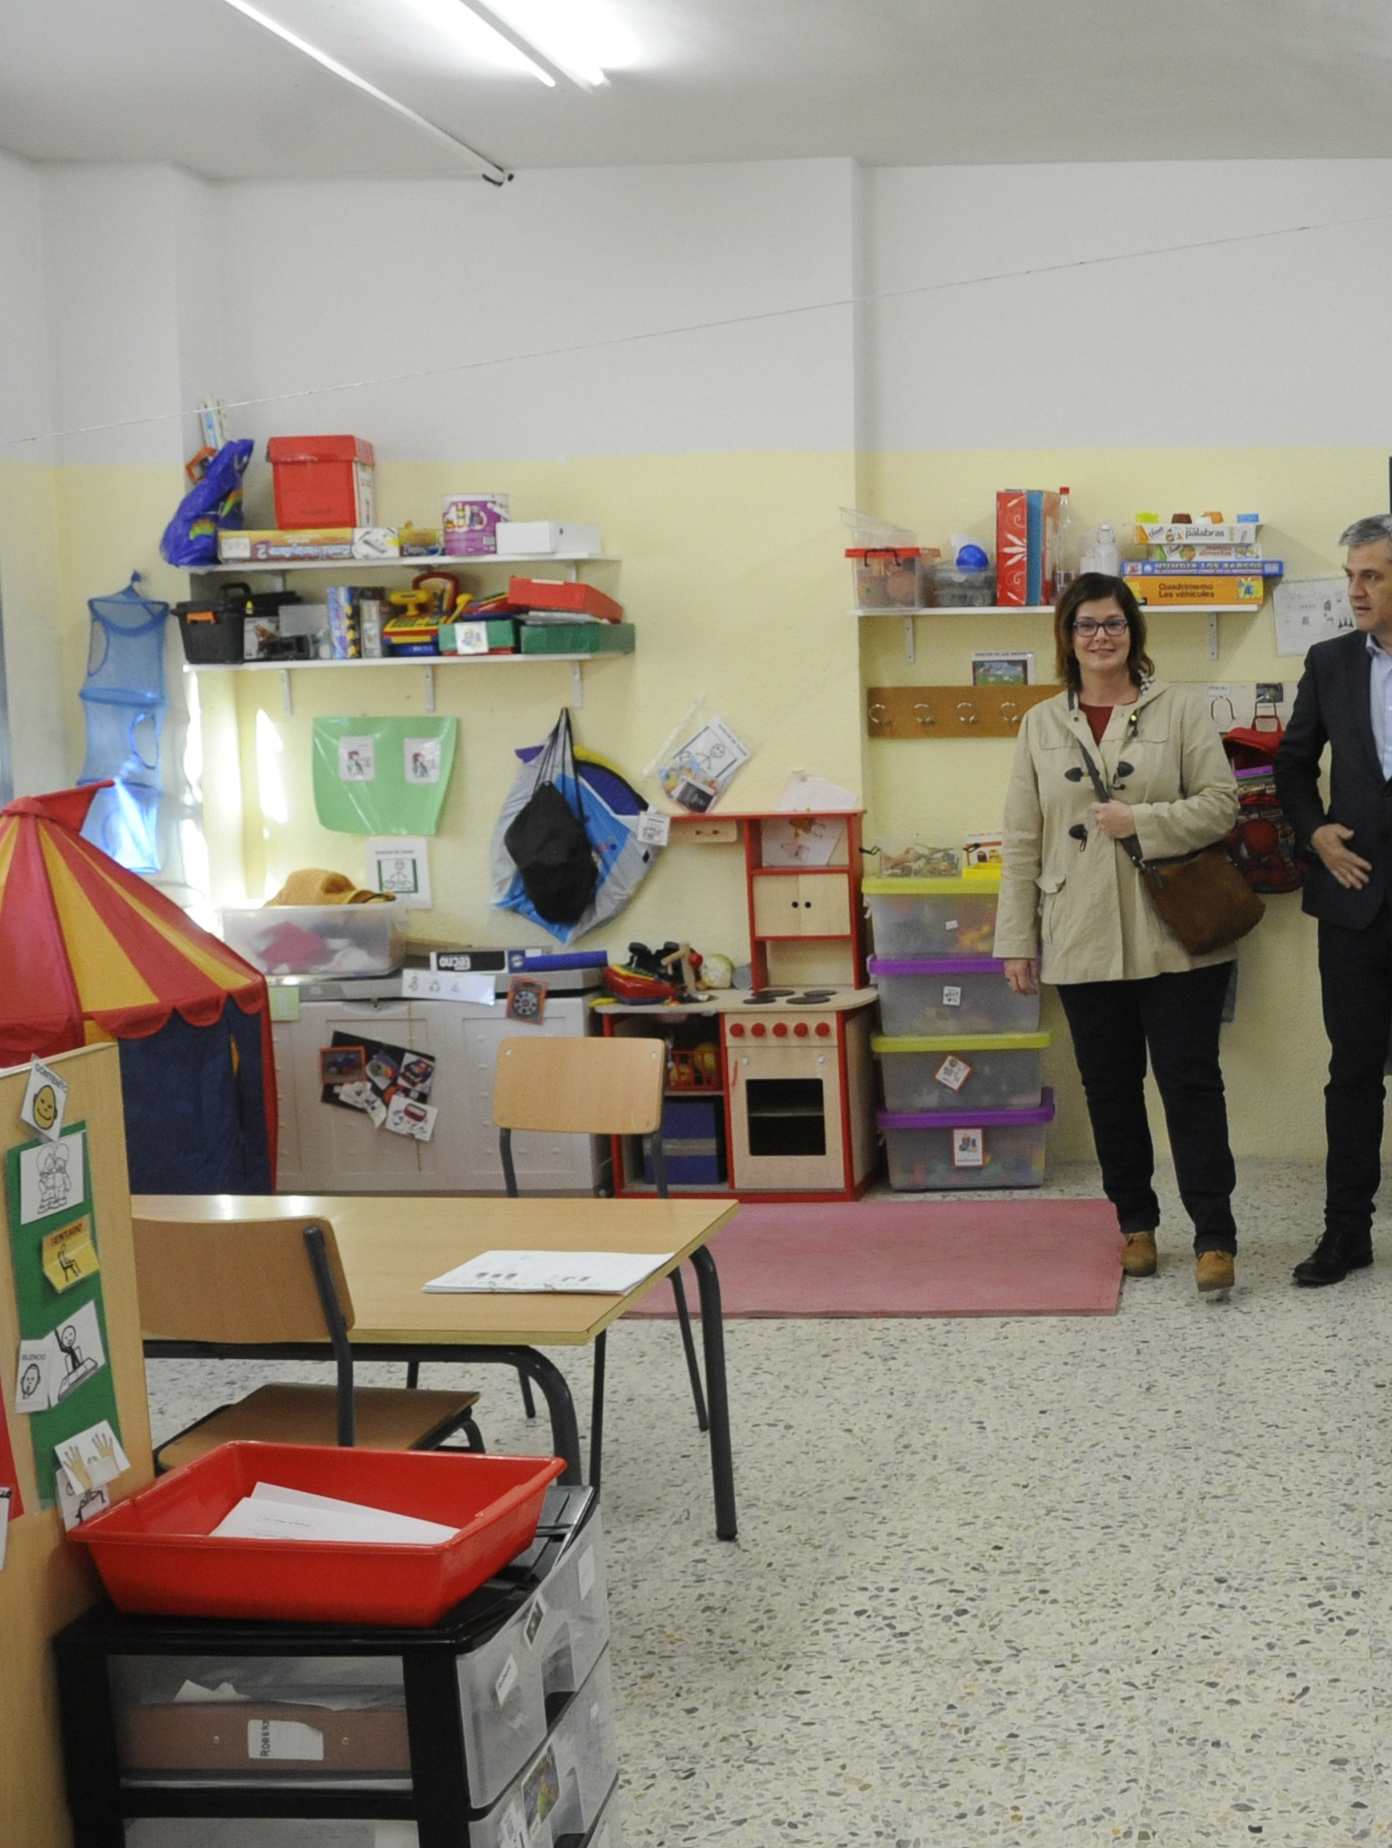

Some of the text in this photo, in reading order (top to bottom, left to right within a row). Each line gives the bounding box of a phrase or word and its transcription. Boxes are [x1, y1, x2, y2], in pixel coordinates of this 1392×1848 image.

[1186, 529, 1225, 540] palabras
[1159, 589, 1215, 598] Les véhicules
